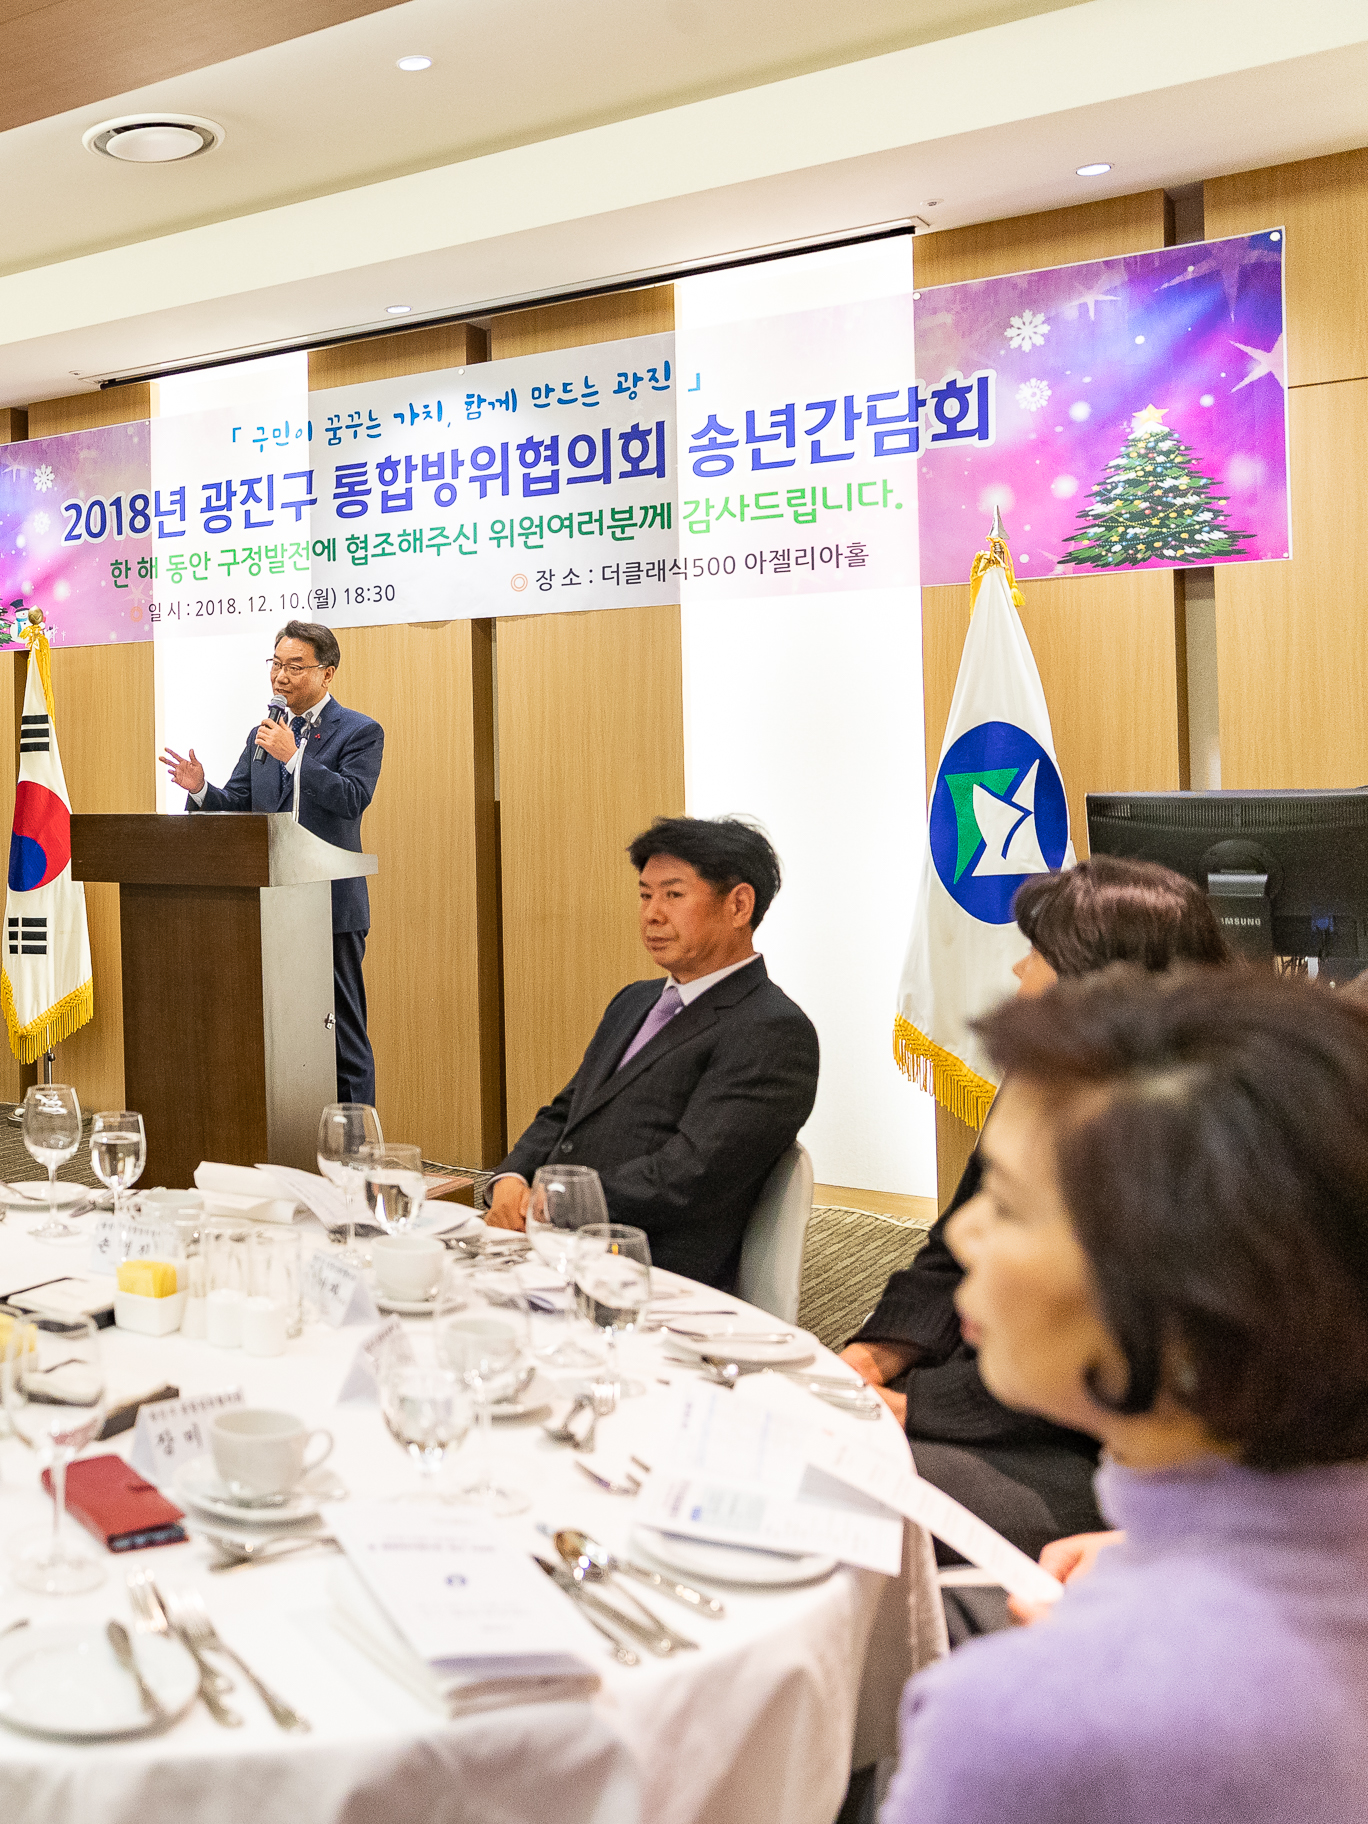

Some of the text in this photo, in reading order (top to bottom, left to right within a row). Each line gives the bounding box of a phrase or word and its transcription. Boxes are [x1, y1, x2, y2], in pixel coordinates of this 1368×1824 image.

[252, 420, 313, 453] 구민이
[324, 409, 382, 447] 꿈꾸는
[392, 399, 451, 428] 가치,
[464, 387, 518, 421] 함께
[531, 375, 600, 409] 만드는
[612, 359, 672, 401] 광진
[64, 375, 990, 542] 2018년 광진구 통합방위협의회 송년간담회
[165, 551, 212, 584] 동안
[217, 537, 337, 577] 구정발전에
[345, 522, 478, 567] 협조해주신
[489, 502, 672, 550] 위원여러분께
[682, 479, 903, 534] 감사드립니다.
[601, 555, 736, 587] 더클래식500
[744, 541, 870, 575] 아젤리아홀
[344, 584, 396, 605] 18:30
[1220, 916, 1262, 927] MSUNG
